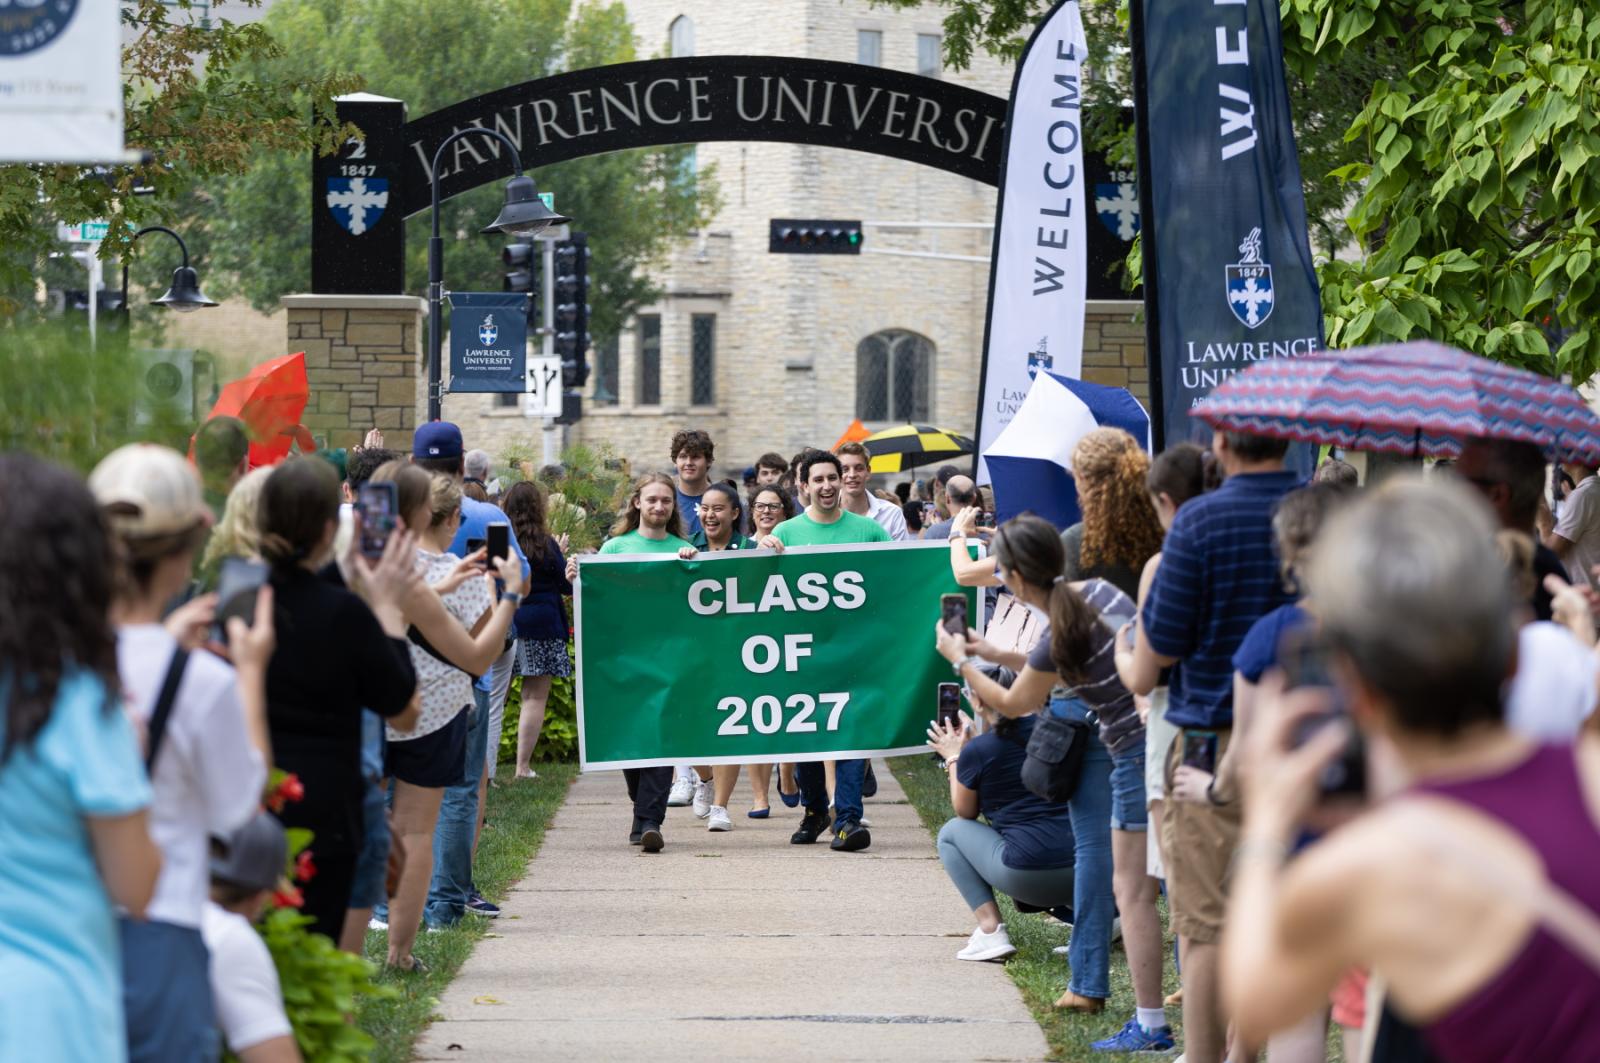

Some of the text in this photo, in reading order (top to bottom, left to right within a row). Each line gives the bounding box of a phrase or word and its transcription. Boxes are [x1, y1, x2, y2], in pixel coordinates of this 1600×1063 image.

[410, 75, 1006, 185] LAWRENCE UNIVERSI
[340, 165, 377, 176] 1847
[1033, 39, 1081, 296] WELCOME
[1109, 171, 1137, 182] 184
[1238, 268, 1265, 278] 1847
[463, 357, 514, 365] UNIVERSITY
[465, 348, 511, 357] LAWRENCE
[1187, 337, 1317, 363] LAWRENCE
[687, 570, 866, 616] CLASS
[741, 633, 814, 674] OF
[717, 692, 850, 737] 2027
